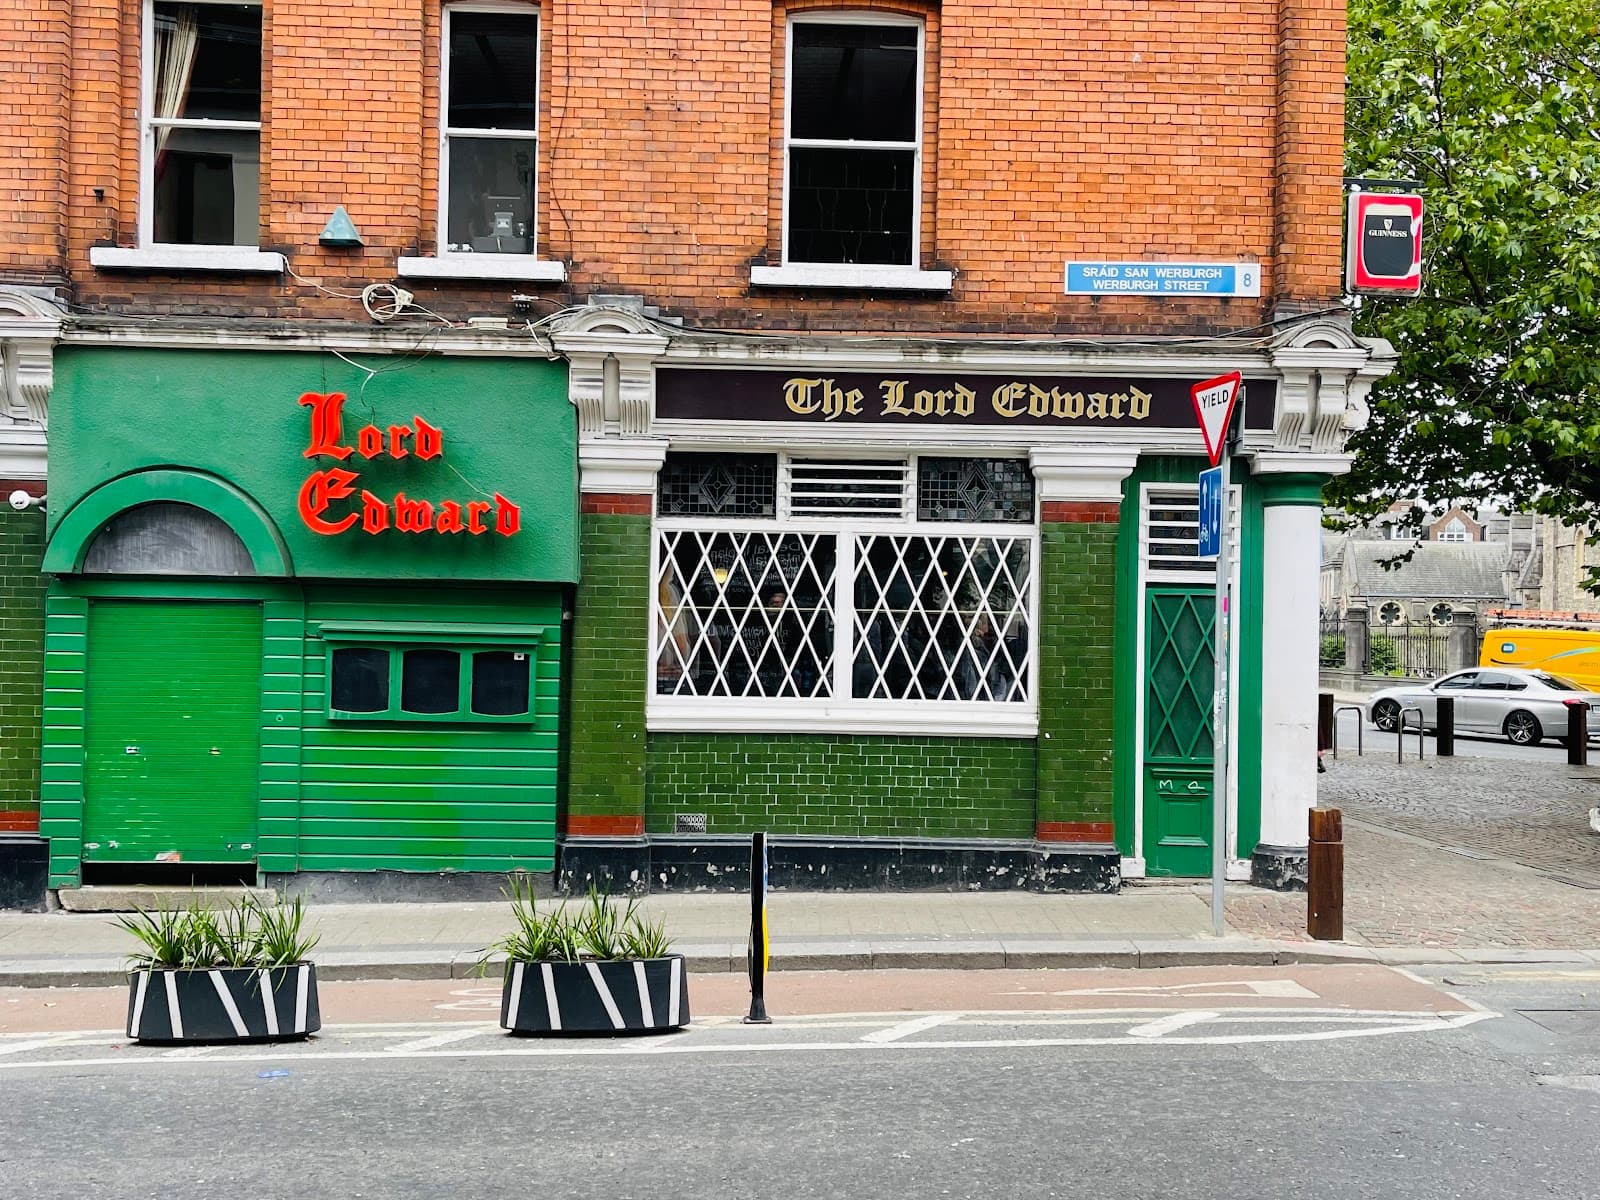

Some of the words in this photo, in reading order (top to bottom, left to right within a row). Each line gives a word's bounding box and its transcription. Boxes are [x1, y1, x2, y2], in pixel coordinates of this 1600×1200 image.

[1368, 229, 1408, 238] GUINNESS
[1082, 264, 1119, 278] SRÁID
[1124, 267, 1149, 278] SAN
[1155, 268, 1223, 279] WERBURGH
[1243, 273, 1252, 287] 8
[1093, 279, 1159, 290] WERBURGH
[1164, 280, 1210, 291] STREET
[782, 378, 865, 422] The
[878, 379, 977, 418] Lord
[992, 382, 1152, 420] Edward
[1201, 390, 1229, 409] YIELD
[298, 392, 443, 461] Lord
[297, 467, 522, 537] Edward
